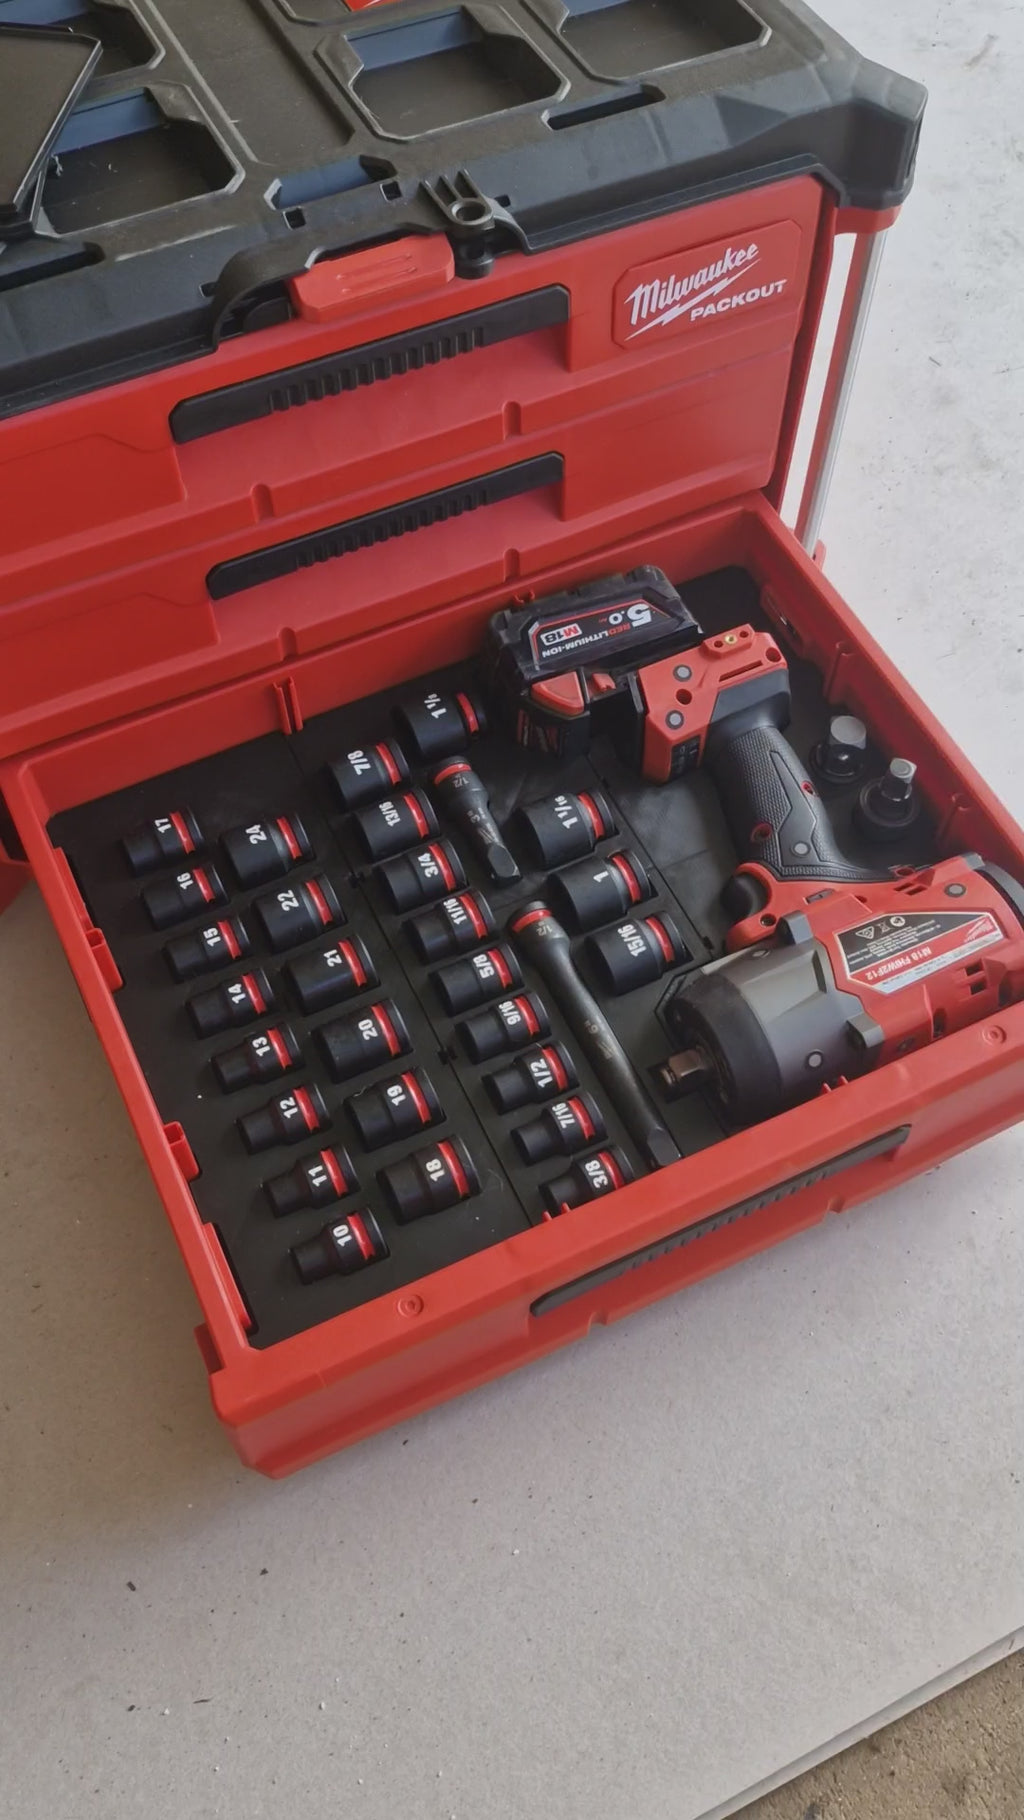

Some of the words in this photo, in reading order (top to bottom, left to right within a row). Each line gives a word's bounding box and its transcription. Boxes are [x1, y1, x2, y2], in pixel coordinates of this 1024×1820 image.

[624, 243, 759, 326] Milwaukee
[690, 279, 788, 321] PACKOUT
[608, 603, 653, 628] 5.0
[544, 625, 579, 645] M18
[347, 750, 372, 776] 7/8
[379, 801, 401, 827] 13/16
[155, 818, 172, 834] 17
[245, 824, 267, 845] 24
[417, 852, 439, 878] 3/4
[593, 870, 609, 883] 1
[177, 872, 194, 890] 16
[277, 890, 299, 912] 22
[443, 898, 468, 925] 11/16
[203, 928, 221, 947] 15
[617, 923, 647, 957] 15/16
[323, 949, 343, 967] 21
[473, 954, 495, 979] 5/8
[228, 983, 246, 1004] 14
[499, 1000, 522, 1026] 9/16
[358, 1018, 379, 1041] 20
[252, 1036, 271, 1057] 13
[530, 1058, 553, 1088] 1/2
[387, 1084, 407, 1107] 19
[279, 1096, 299, 1119] 12
[552, 1102, 575, 1129] 7/16
[308, 1165, 328, 1187] 11
[425, 1158, 446, 1182] 18
[585, 1159, 609, 1189] 3/8
[333, 1224, 354, 1247] 10
